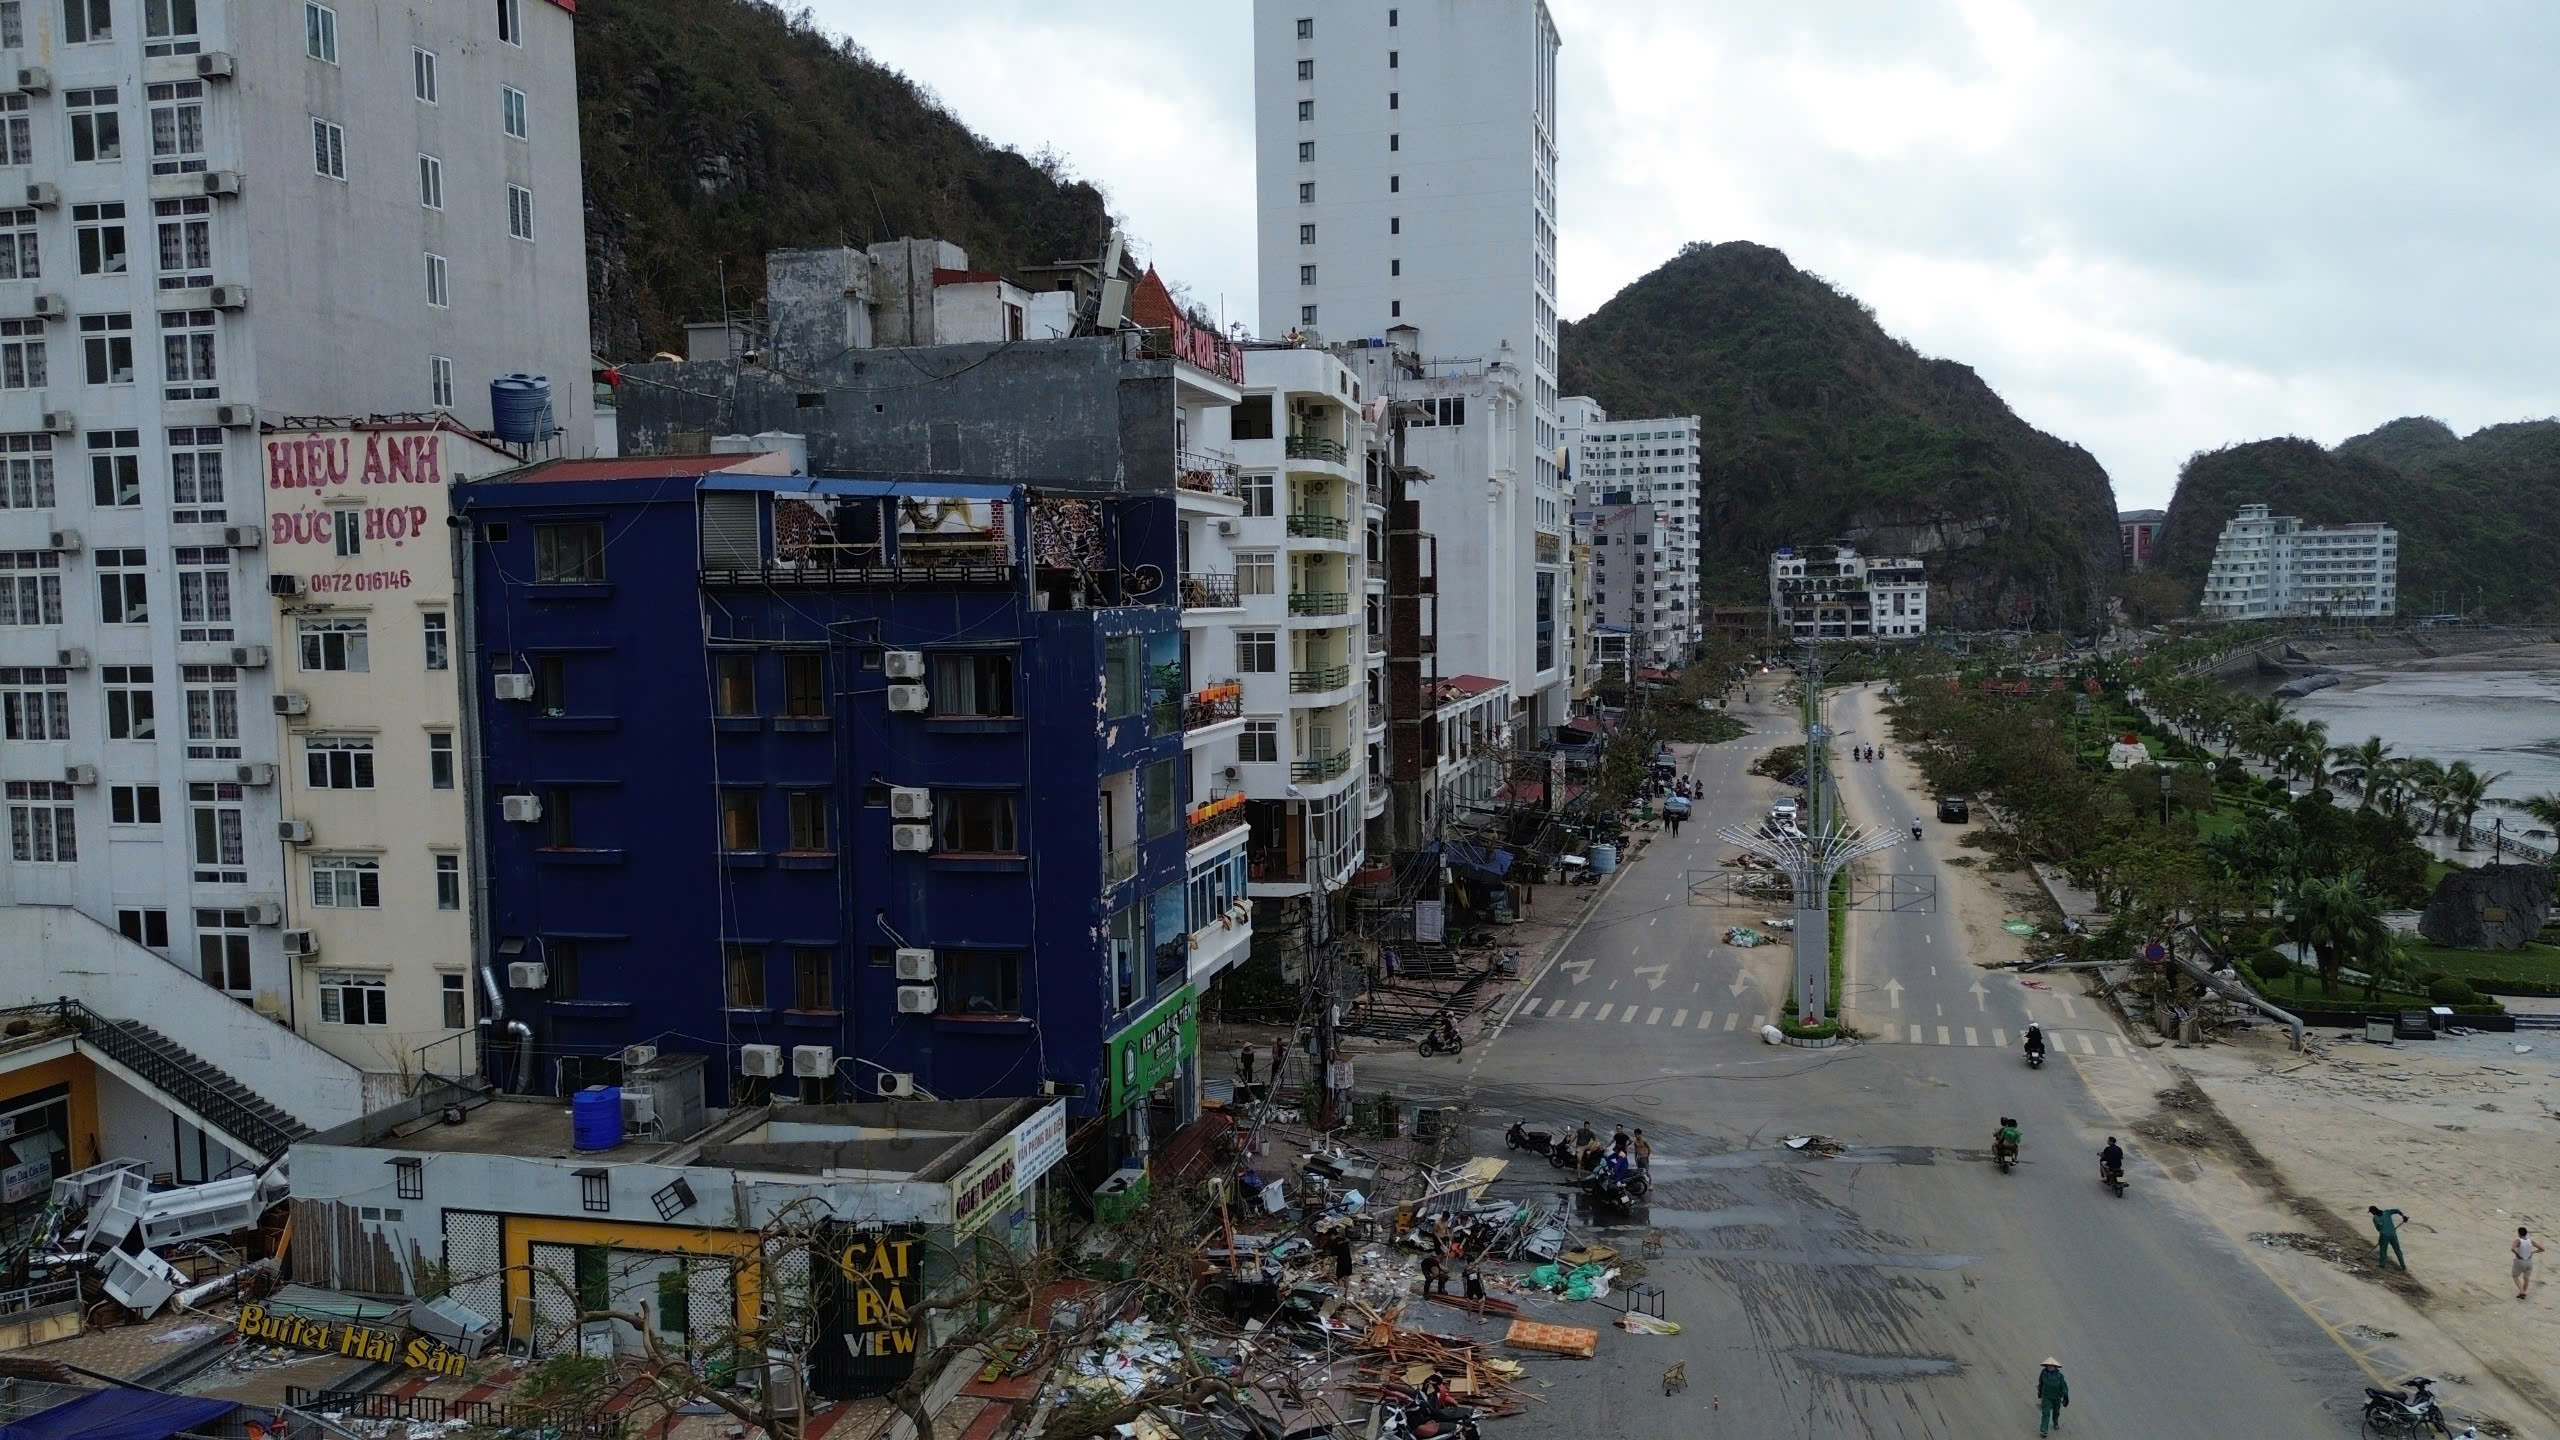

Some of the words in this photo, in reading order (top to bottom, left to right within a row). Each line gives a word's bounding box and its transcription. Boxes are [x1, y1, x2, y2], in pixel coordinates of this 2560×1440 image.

[268, 433, 349, 495] HIỆU
[361, 432, 440, 484] ẢNH
[272, 504, 332, 544] ĐỨC
[365, 506, 427, 547] HỢP
[311, 574, 352, 592] 0972
[355, 570, 412, 591] 016146
[1142, 1030, 1157, 1054] KEM
[238, 1303, 334, 1350] Buffet
[341, 1323, 399, 1364] Hải
[404, 1337, 468, 1377] Sản
[843, 1328, 917, 1357] VIEW
